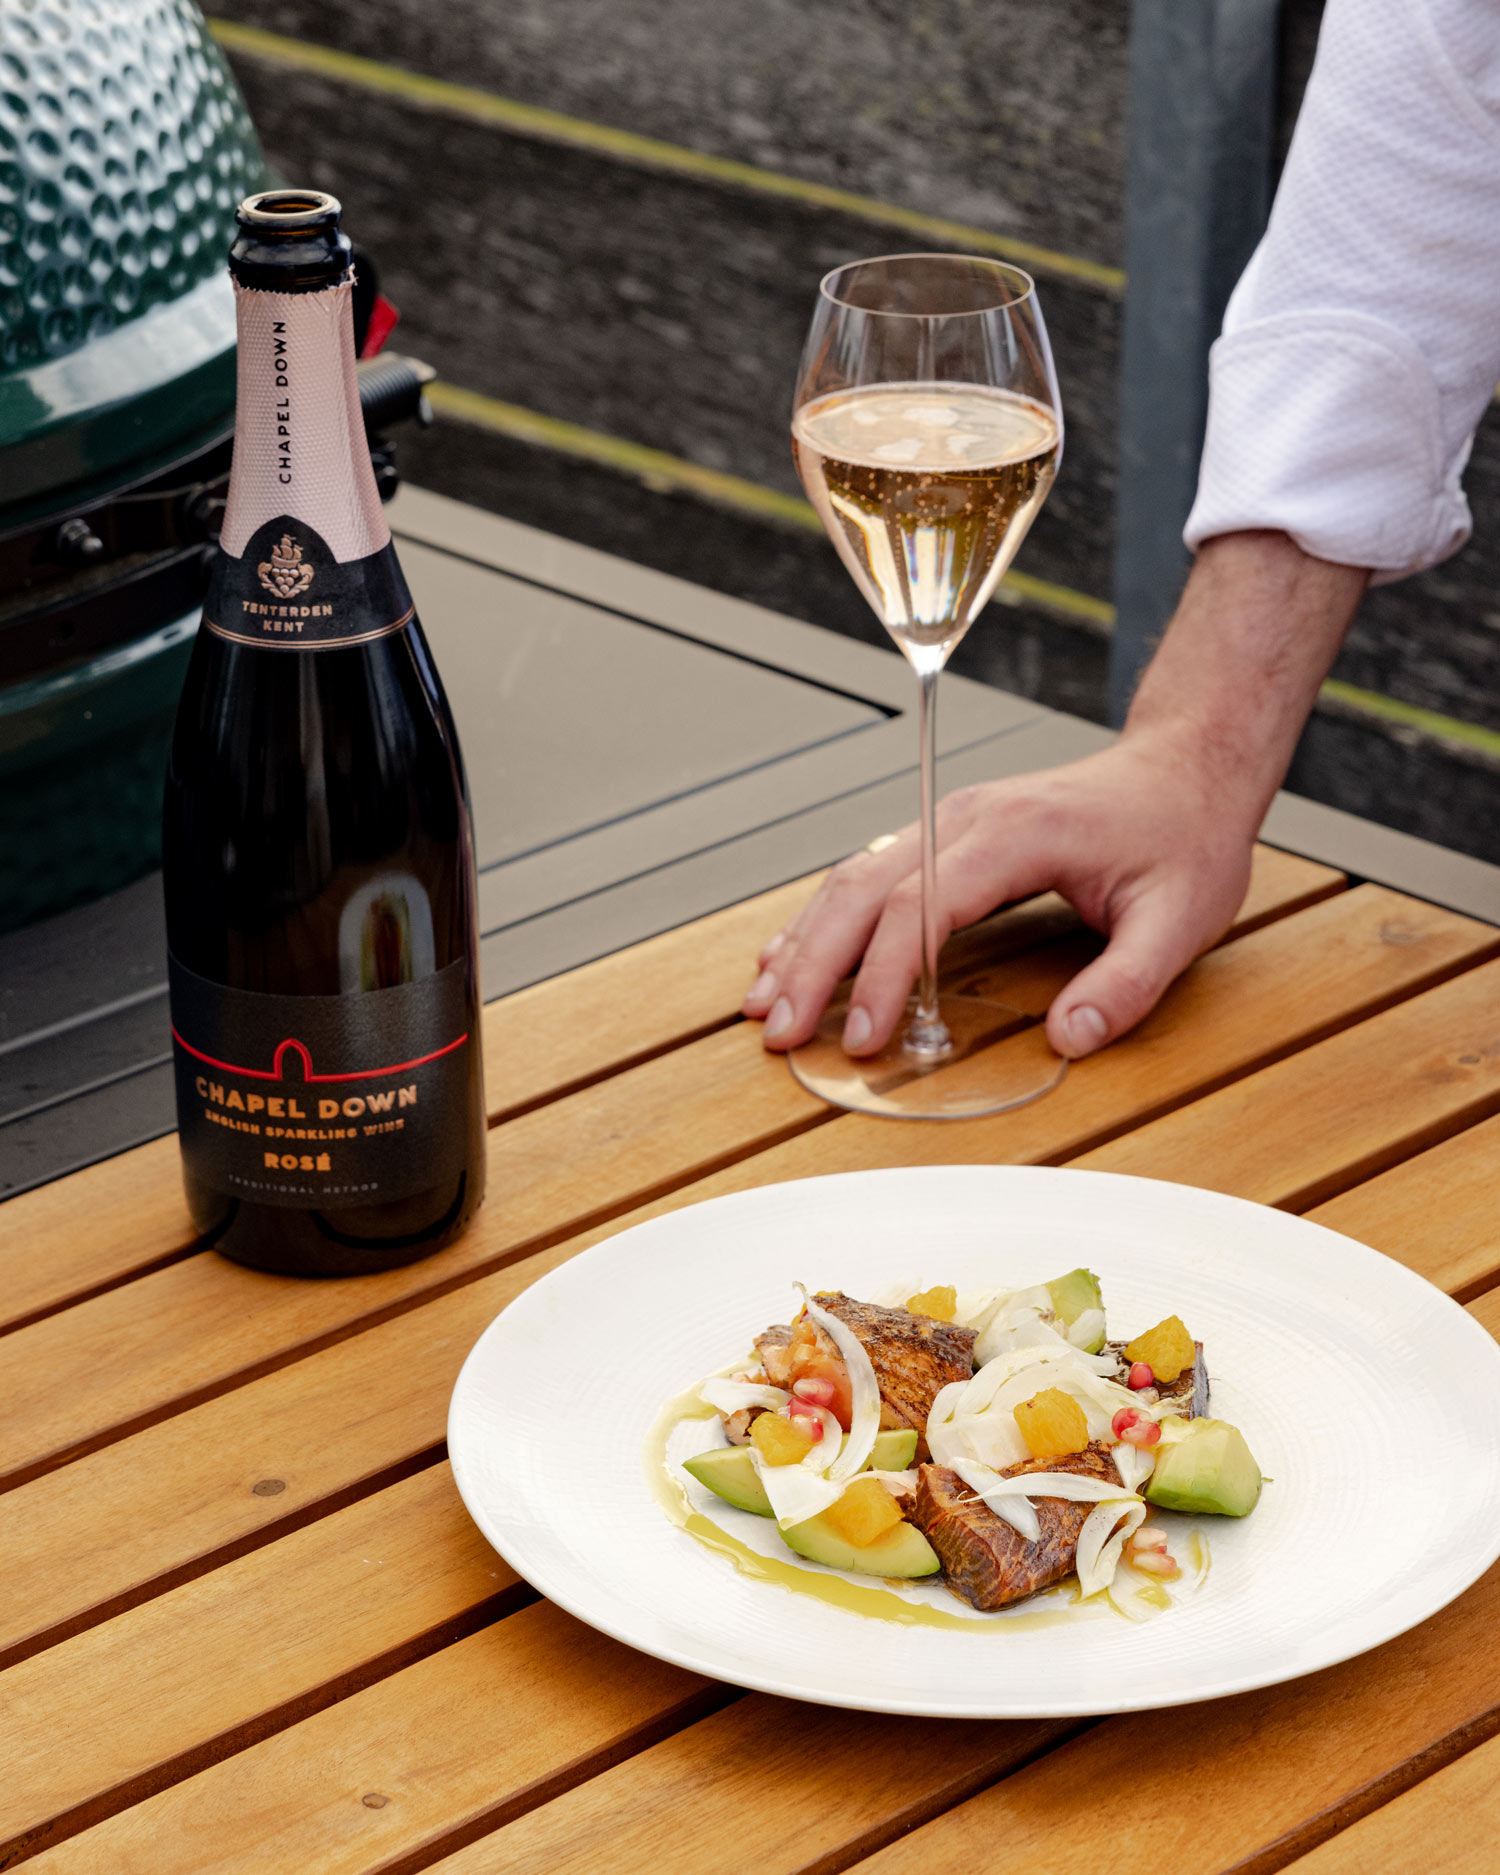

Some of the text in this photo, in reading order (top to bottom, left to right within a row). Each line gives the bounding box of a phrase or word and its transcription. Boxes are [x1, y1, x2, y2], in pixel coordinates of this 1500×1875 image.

[272, 321, 292, 485] CHAPEL DOWN
[242, 600, 333, 618] TENTERDEN
[263, 619, 305, 633] KENT
[195, 1076, 417, 1119] CHAPEL DOWN
[204, 1108, 405, 1140] ENGLISH SPARKLING WINE
[264, 1152, 332, 1172] ROSÉ
[228, 1174, 379, 1194] TRADITIONAL METHOD
